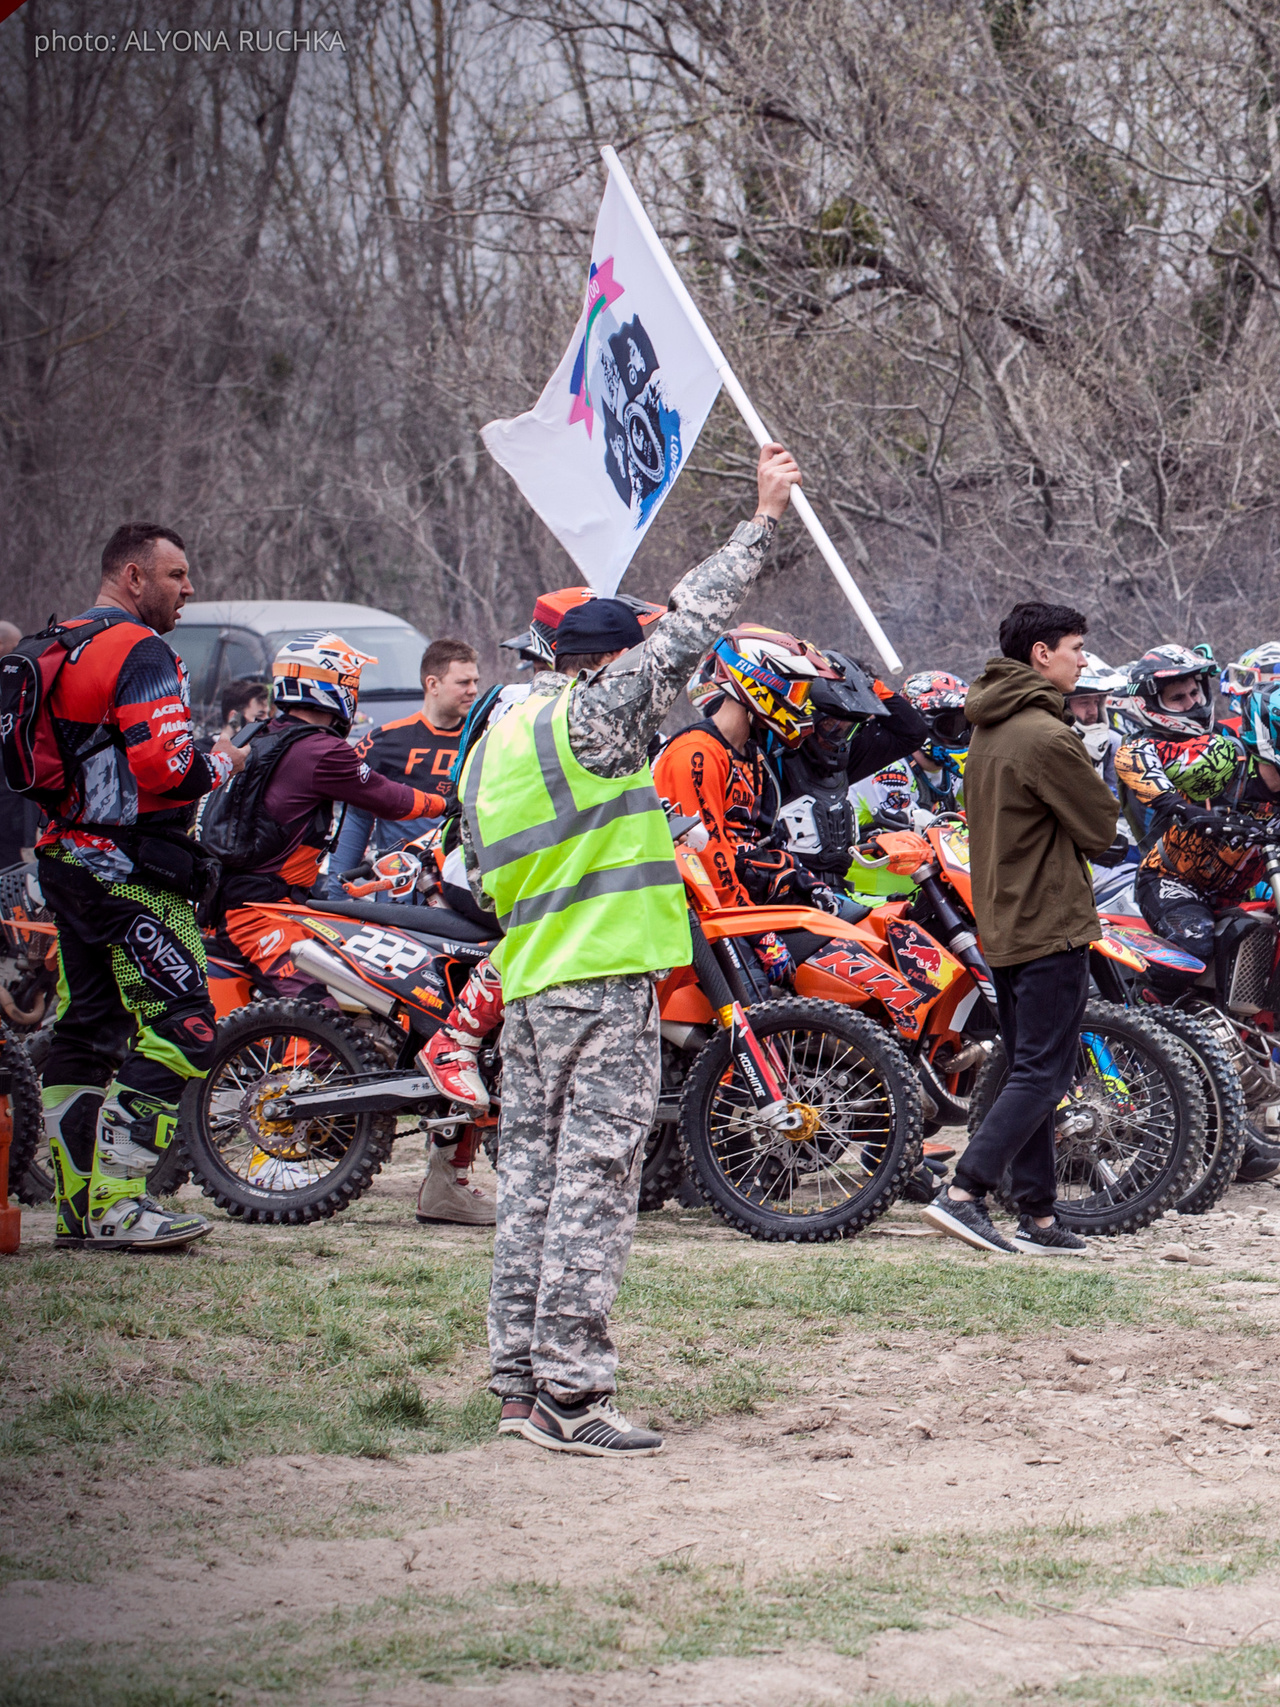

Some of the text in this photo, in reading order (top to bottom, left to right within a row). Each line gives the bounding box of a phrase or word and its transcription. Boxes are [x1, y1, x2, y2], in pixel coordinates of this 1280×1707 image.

[736, 659, 786, 691] FLY RACING
[404, 748, 460, 776] FO
[339, 925, 429, 980] 222
[814, 949, 926, 1012] KTM
[447, 1075, 475, 1097] UFO
[738, 1051, 766, 1099] KOSHINE
